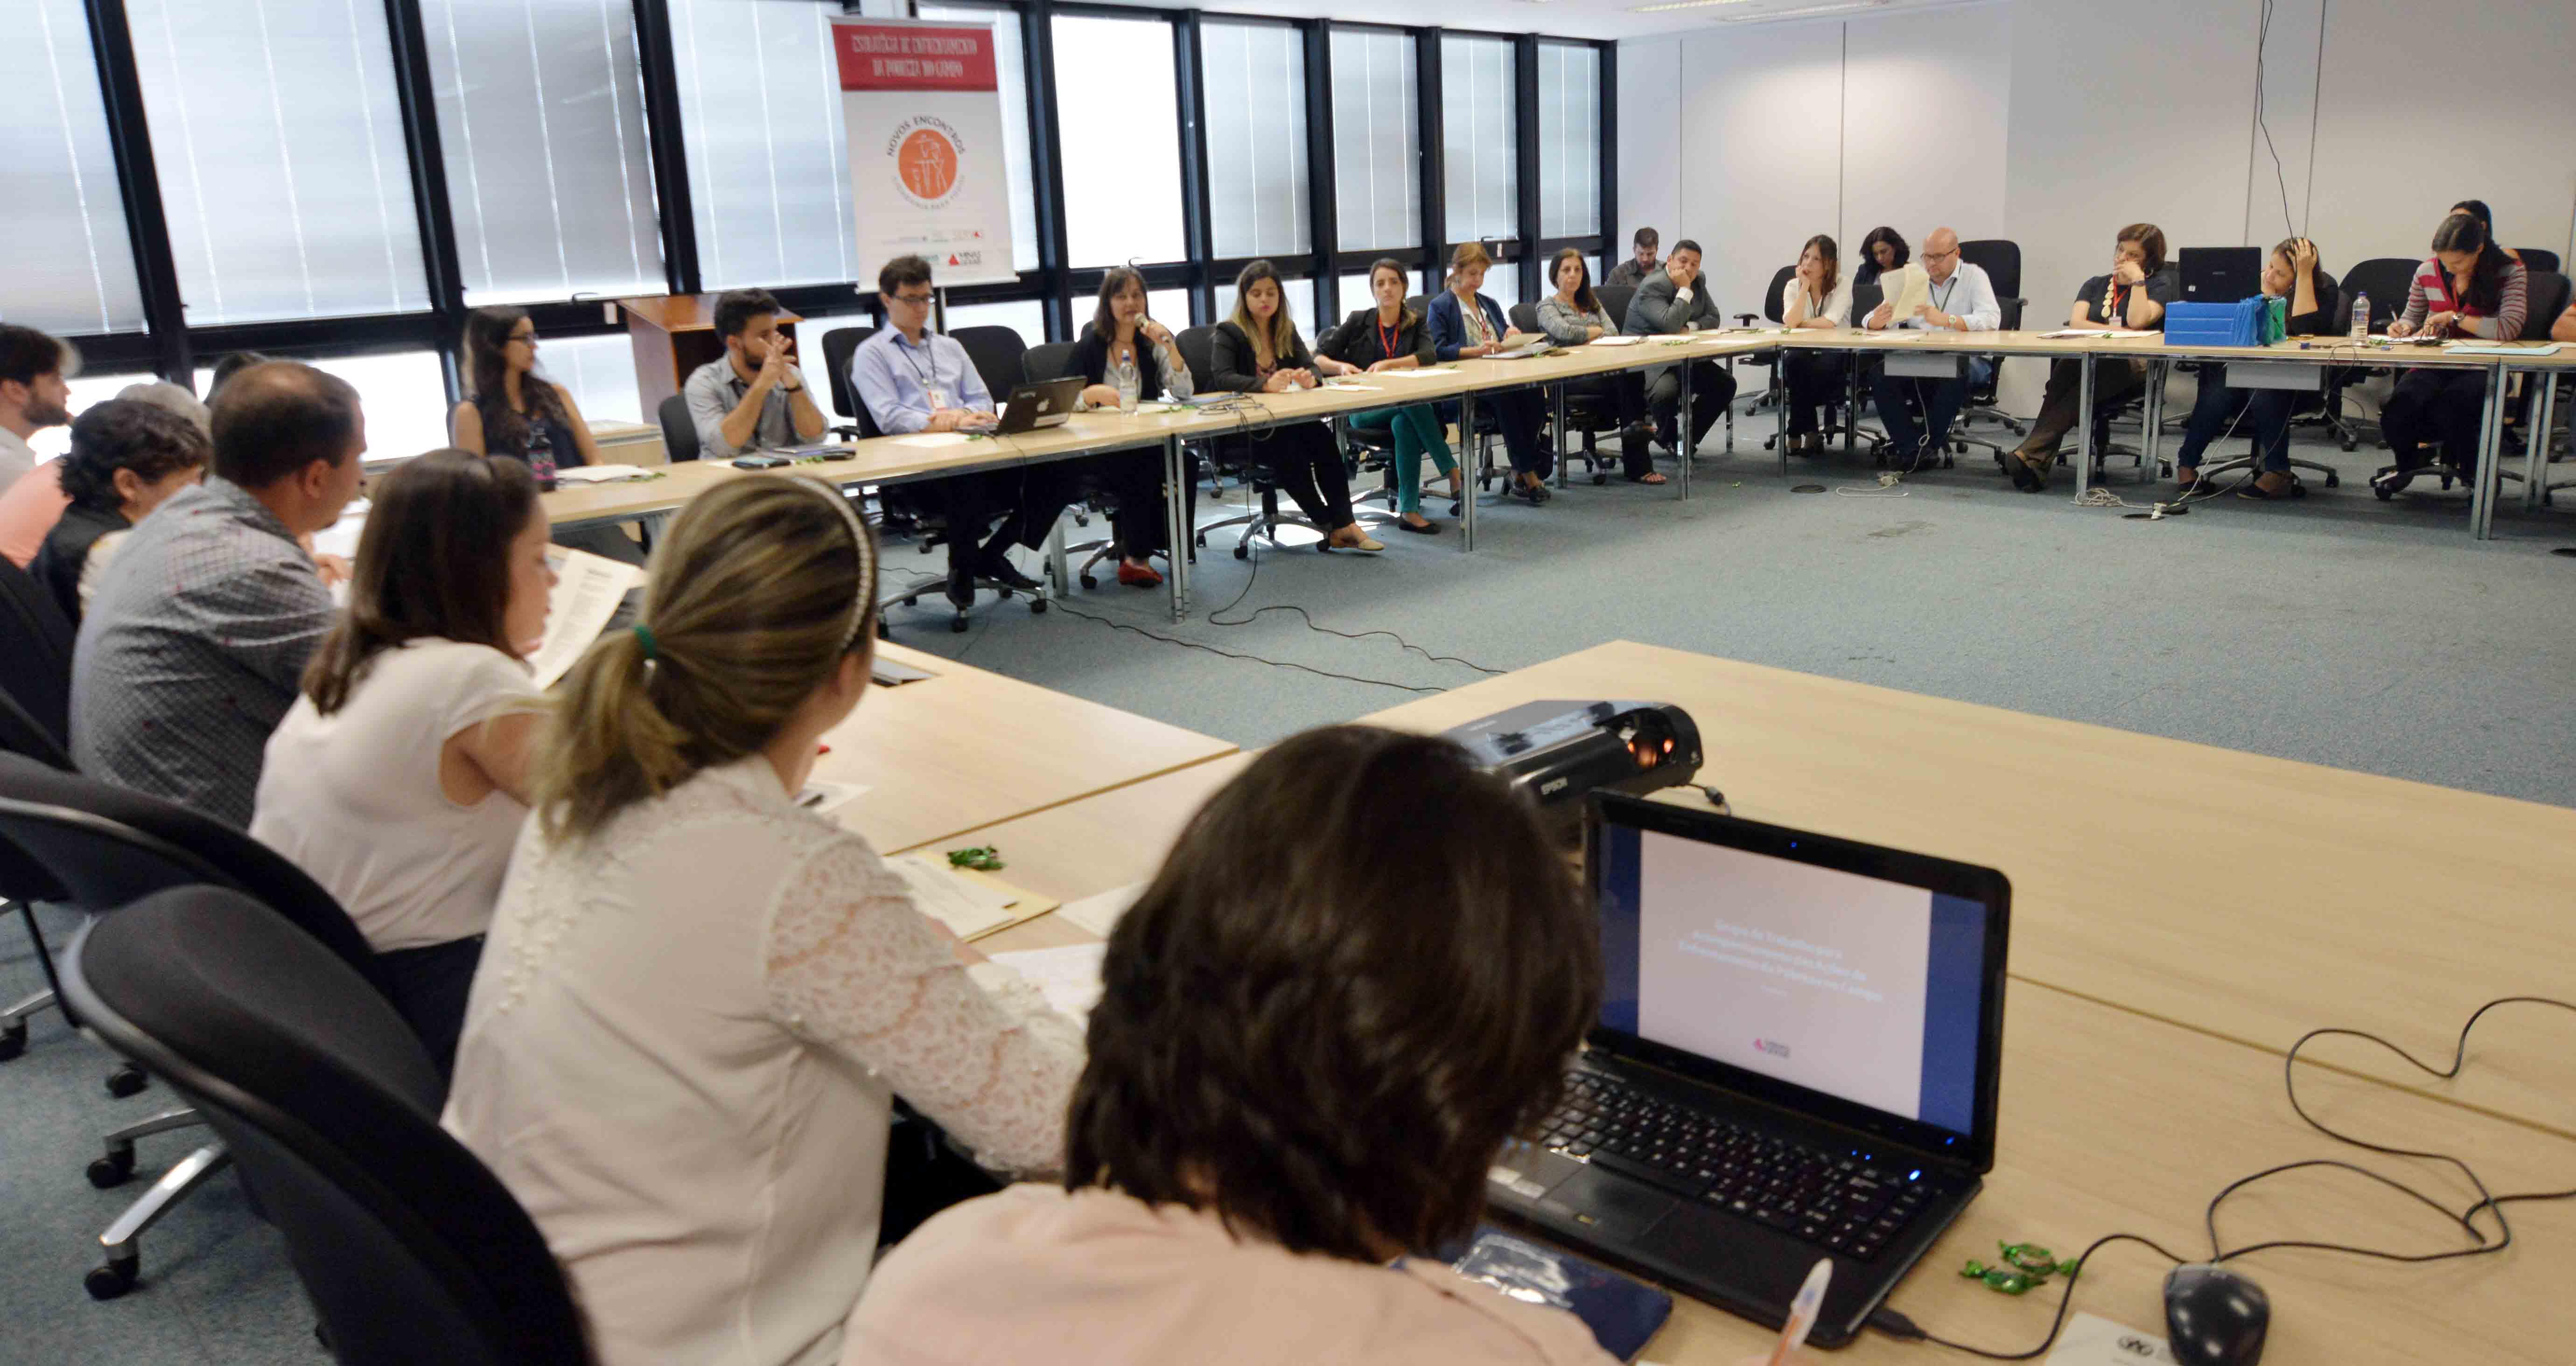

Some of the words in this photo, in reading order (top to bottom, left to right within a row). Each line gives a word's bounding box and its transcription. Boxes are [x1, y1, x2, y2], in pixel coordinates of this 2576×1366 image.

[886, 121, 911, 157] NOVOS
[913, 115, 966, 154] ENCONTROS
[1540, 777, 1568, 795] EPSON
